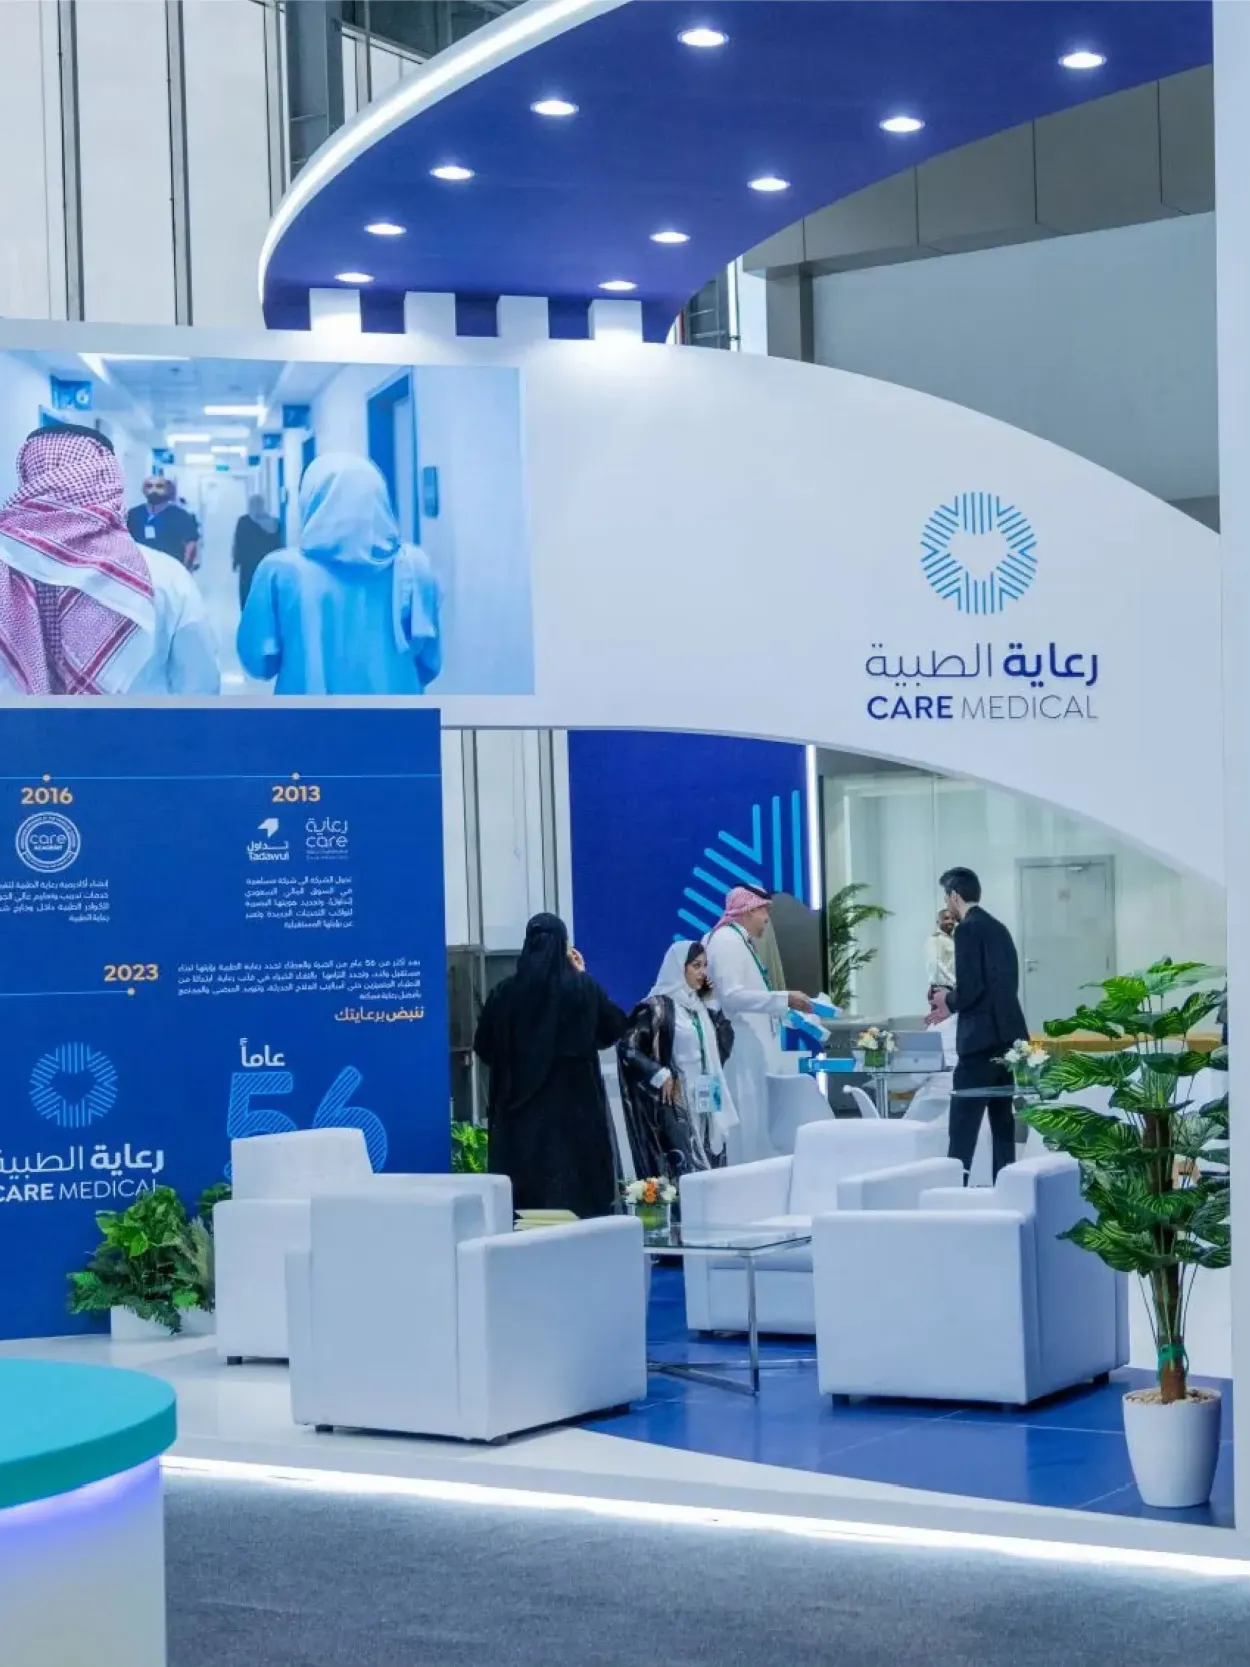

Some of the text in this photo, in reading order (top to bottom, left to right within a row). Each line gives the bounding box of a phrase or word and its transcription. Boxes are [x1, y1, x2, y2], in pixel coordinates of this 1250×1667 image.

[865, 642, 1098, 688] رعاية الطبية
[867, 694, 1099, 720] CARE MEDICAL
[21, 787, 73, 804] 2016
[271, 785, 321, 802] 2013
[305, 817, 349, 836] رعاية
[305, 835, 349, 849] care
[103, 963, 159, 982] 2023
[0, 1143, 164, 1180] رعاية الطبي
